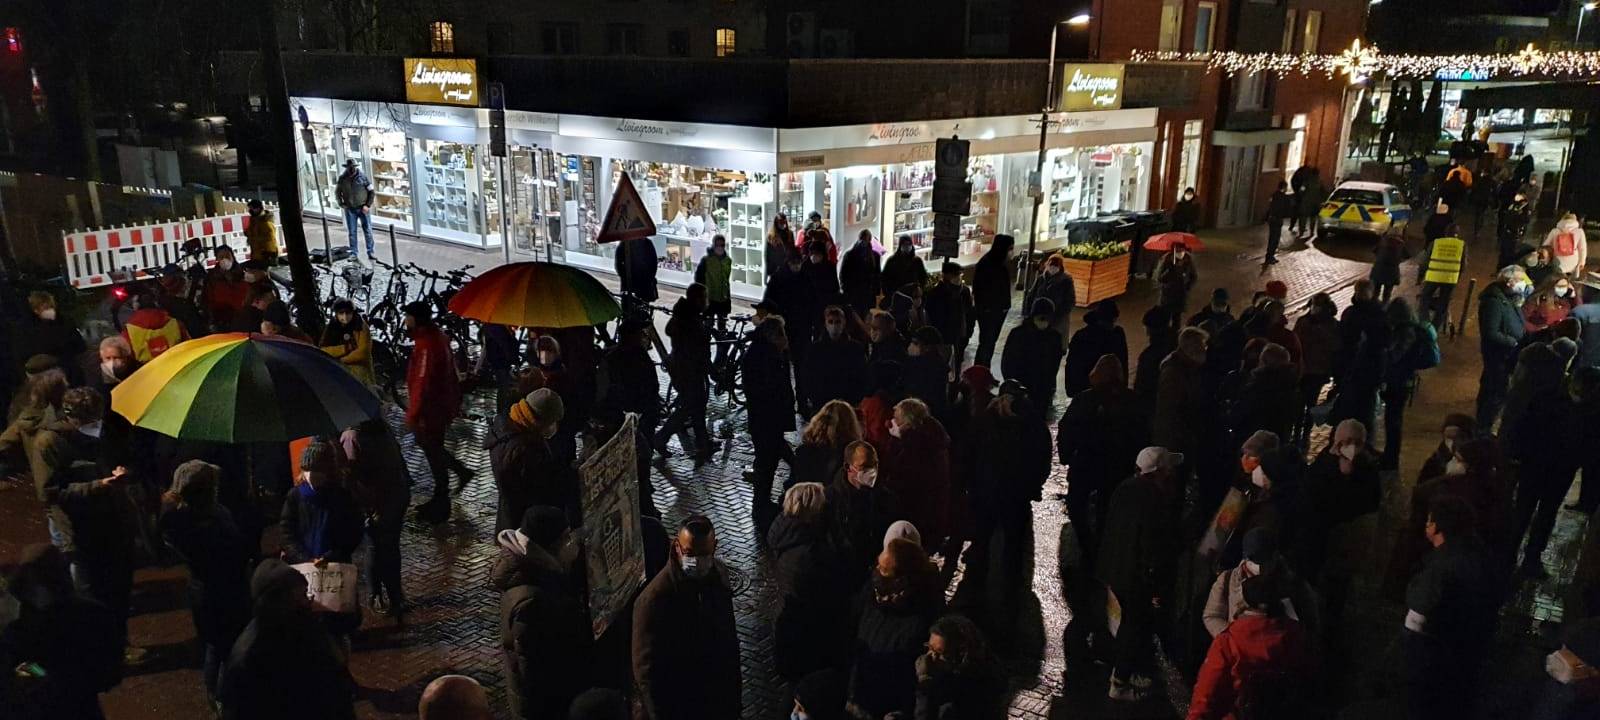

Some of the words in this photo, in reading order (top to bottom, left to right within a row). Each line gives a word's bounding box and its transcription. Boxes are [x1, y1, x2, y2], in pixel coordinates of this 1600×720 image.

[411, 62, 472, 92] Livingroom
[1067, 68, 1118, 98] Livingroom
[616, 119, 663, 137] Livingroom
